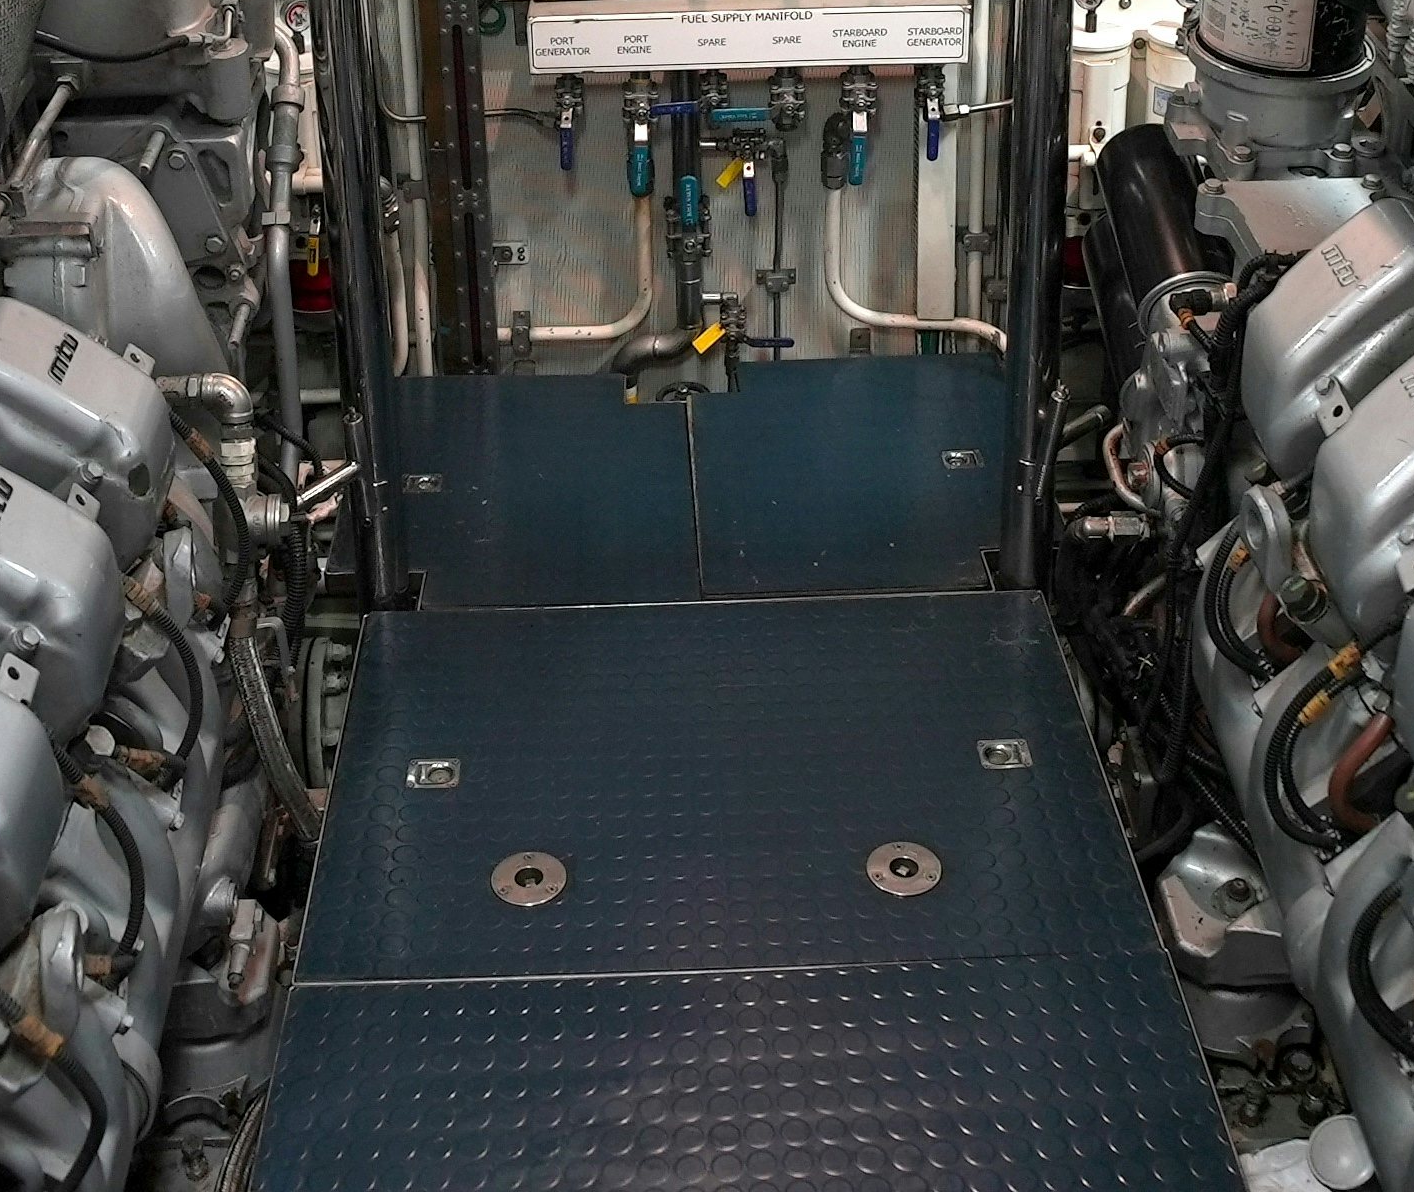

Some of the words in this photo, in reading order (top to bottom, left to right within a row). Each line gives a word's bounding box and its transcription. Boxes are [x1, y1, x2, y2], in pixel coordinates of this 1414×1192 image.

[681, 13, 708, 24] FUEL
[711, 12, 752, 23] SUPPLY
[755, 11, 813, 22] MANIFOLD
[833, 28, 888, 38] STARBOARD
[907, 26, 963, 36] STARBOARD
[550, 36, 575, 46] PORT
[623, 34, 649, 44] PORT
[698, 38, 727, 47] SPARE
[772, 35, 802, 45] SPARE
[842, 38, 878, 48] ENGINE
[906, 37, 963, 47] GENERATOR
[535, 46, 591, 57] GENERATOR
[617, 45, 652, 55] ENGINE
[1321, 243, 1360, 287] mtu
[47, 332, 79, 384] mtu
